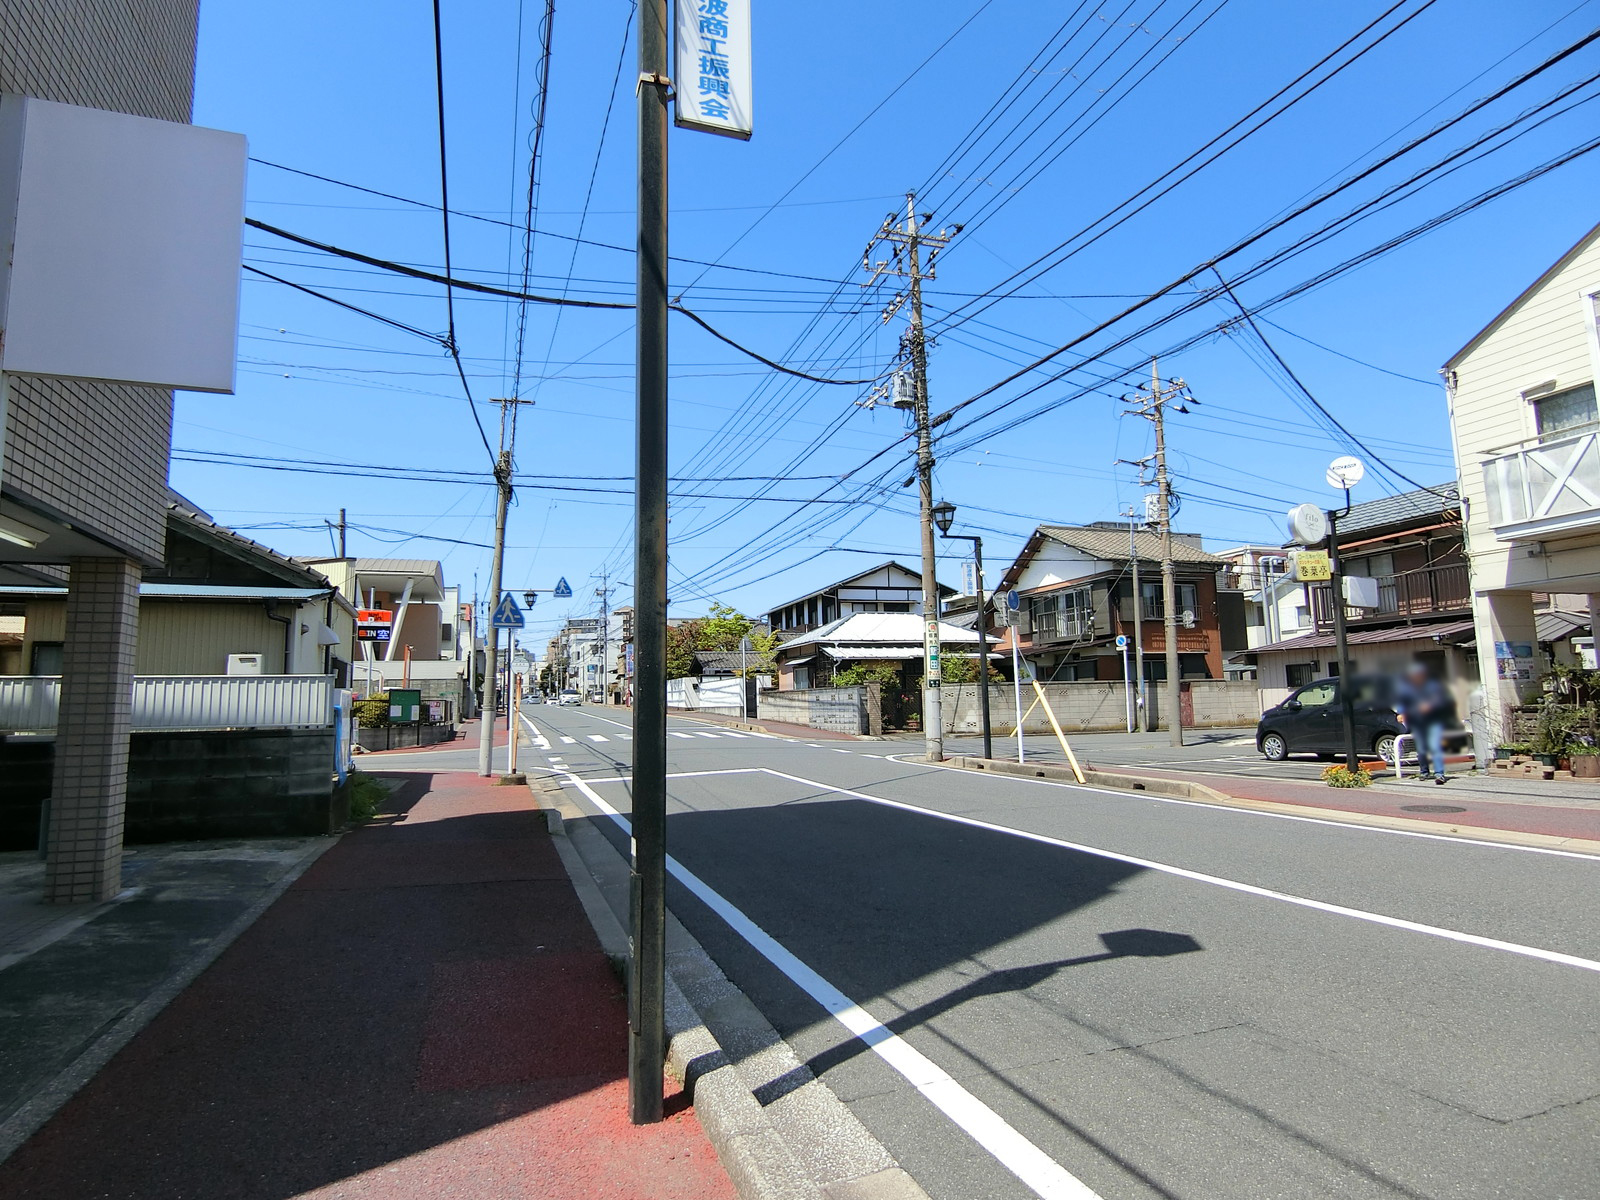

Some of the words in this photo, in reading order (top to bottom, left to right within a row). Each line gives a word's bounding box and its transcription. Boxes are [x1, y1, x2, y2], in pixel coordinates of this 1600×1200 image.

[698, 0, 730, 120] 波商工振興会
[376, 629, 390, 640] 空
